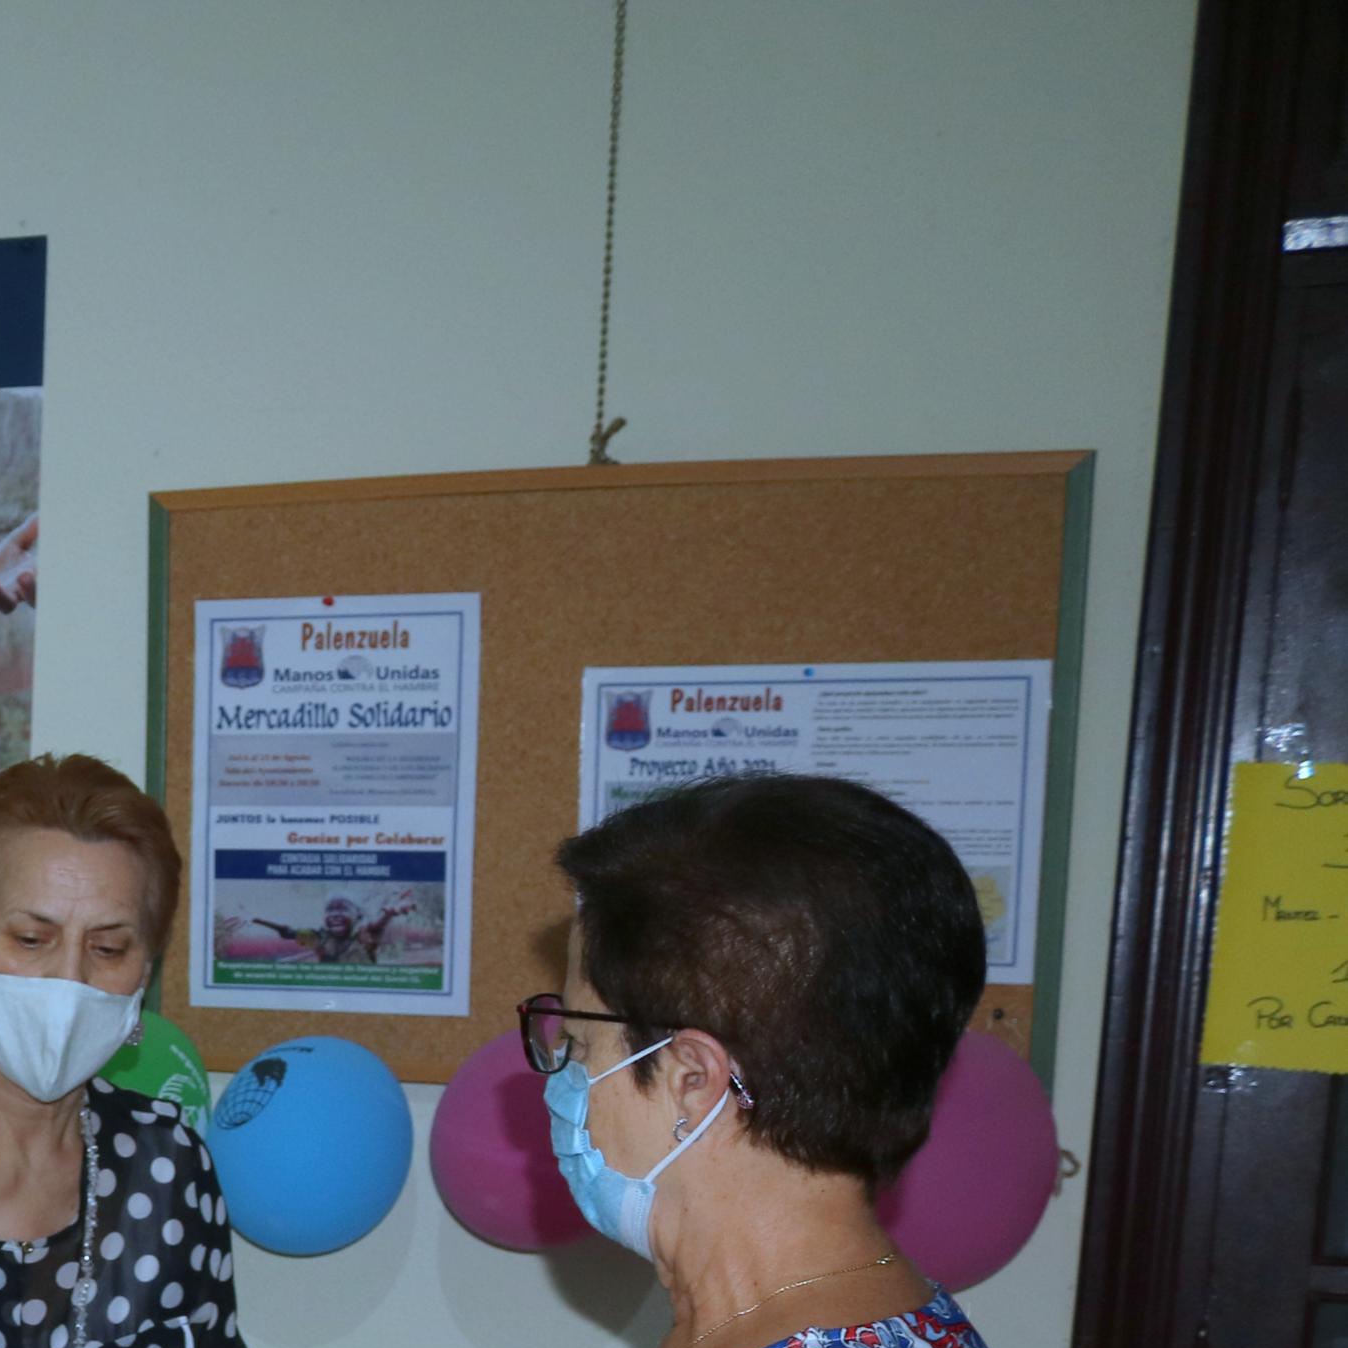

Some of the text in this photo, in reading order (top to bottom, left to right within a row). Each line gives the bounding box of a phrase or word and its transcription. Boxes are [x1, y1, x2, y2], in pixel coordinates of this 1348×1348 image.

[301, 620, 410, 651] Palenzuela
[274, 665, 440, 682] Manos Unidas
[670, 687, 783, 713] Palenzuela
[216, 700, 453, 730] Mercadillo Solidario
[657, 725, 799, 738] Manos Unidas
[216, 814, 262, 825] JUNTOS
[329, 814, 380, 825] POSIBLE
[286, 831, 340, 845] Gracias
